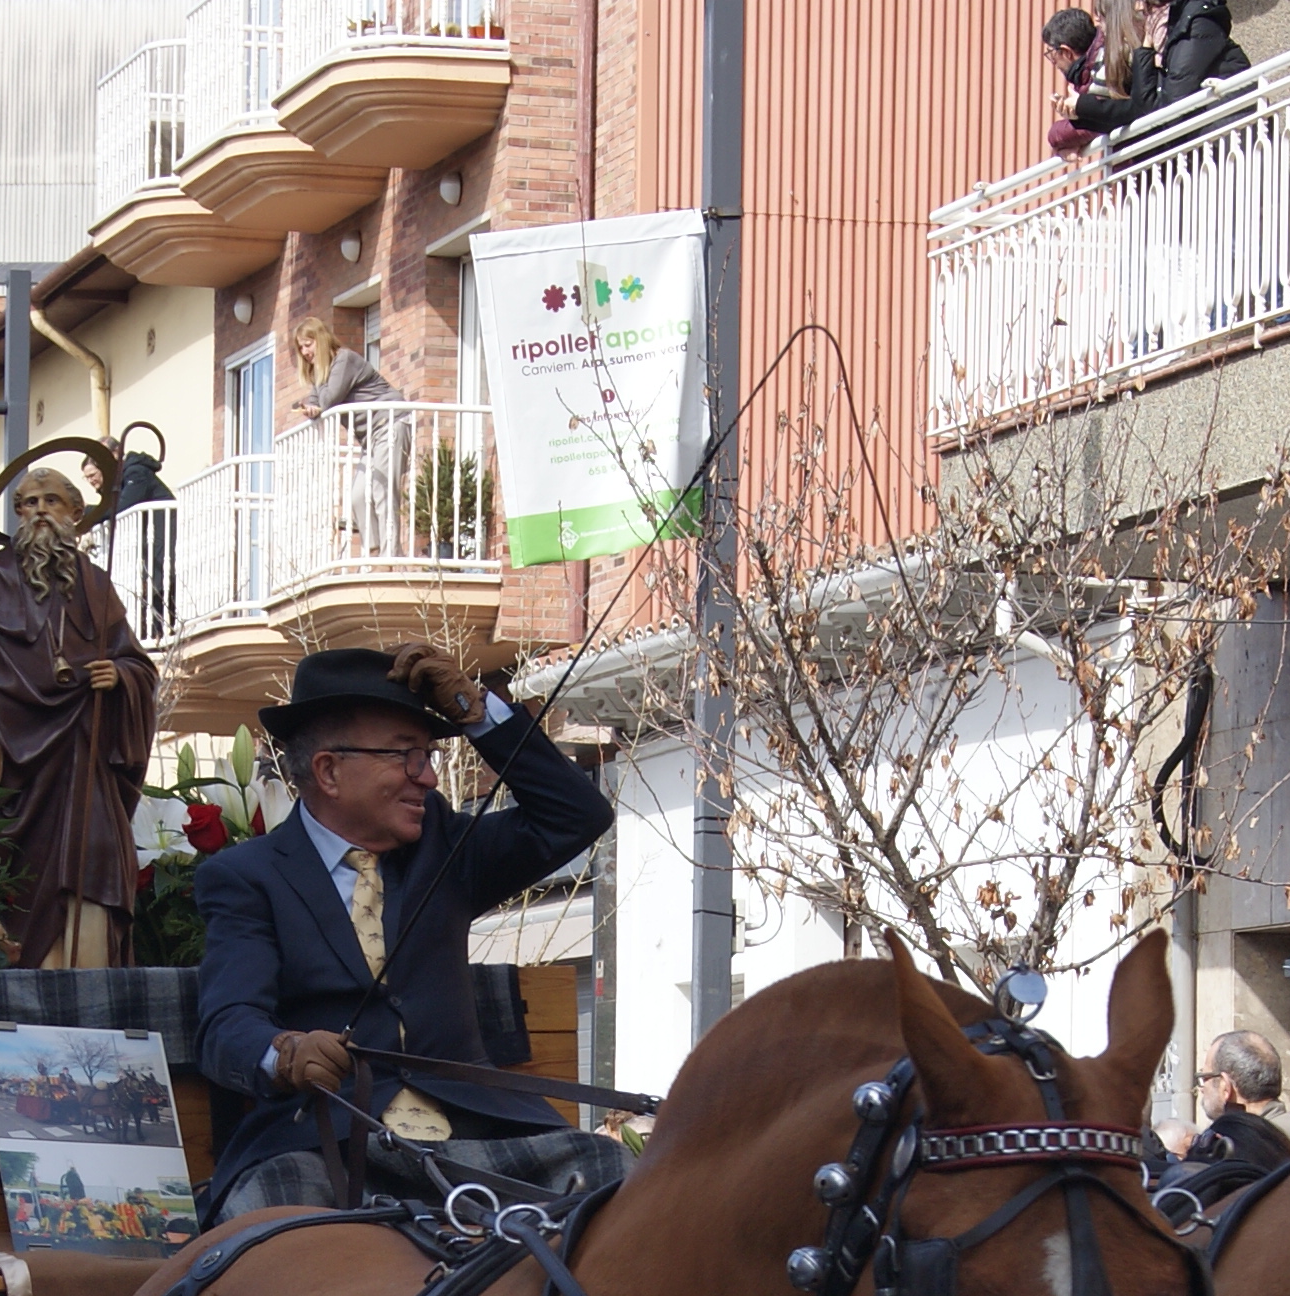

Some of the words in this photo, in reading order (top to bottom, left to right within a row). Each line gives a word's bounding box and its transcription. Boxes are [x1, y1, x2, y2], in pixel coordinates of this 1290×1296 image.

[511, 330, 598, 363] ripollet
[605, 319, 691, 350] aporta
[521, 361, 578, 377] Canviem.
[609, 350, 657, 366] sumem
